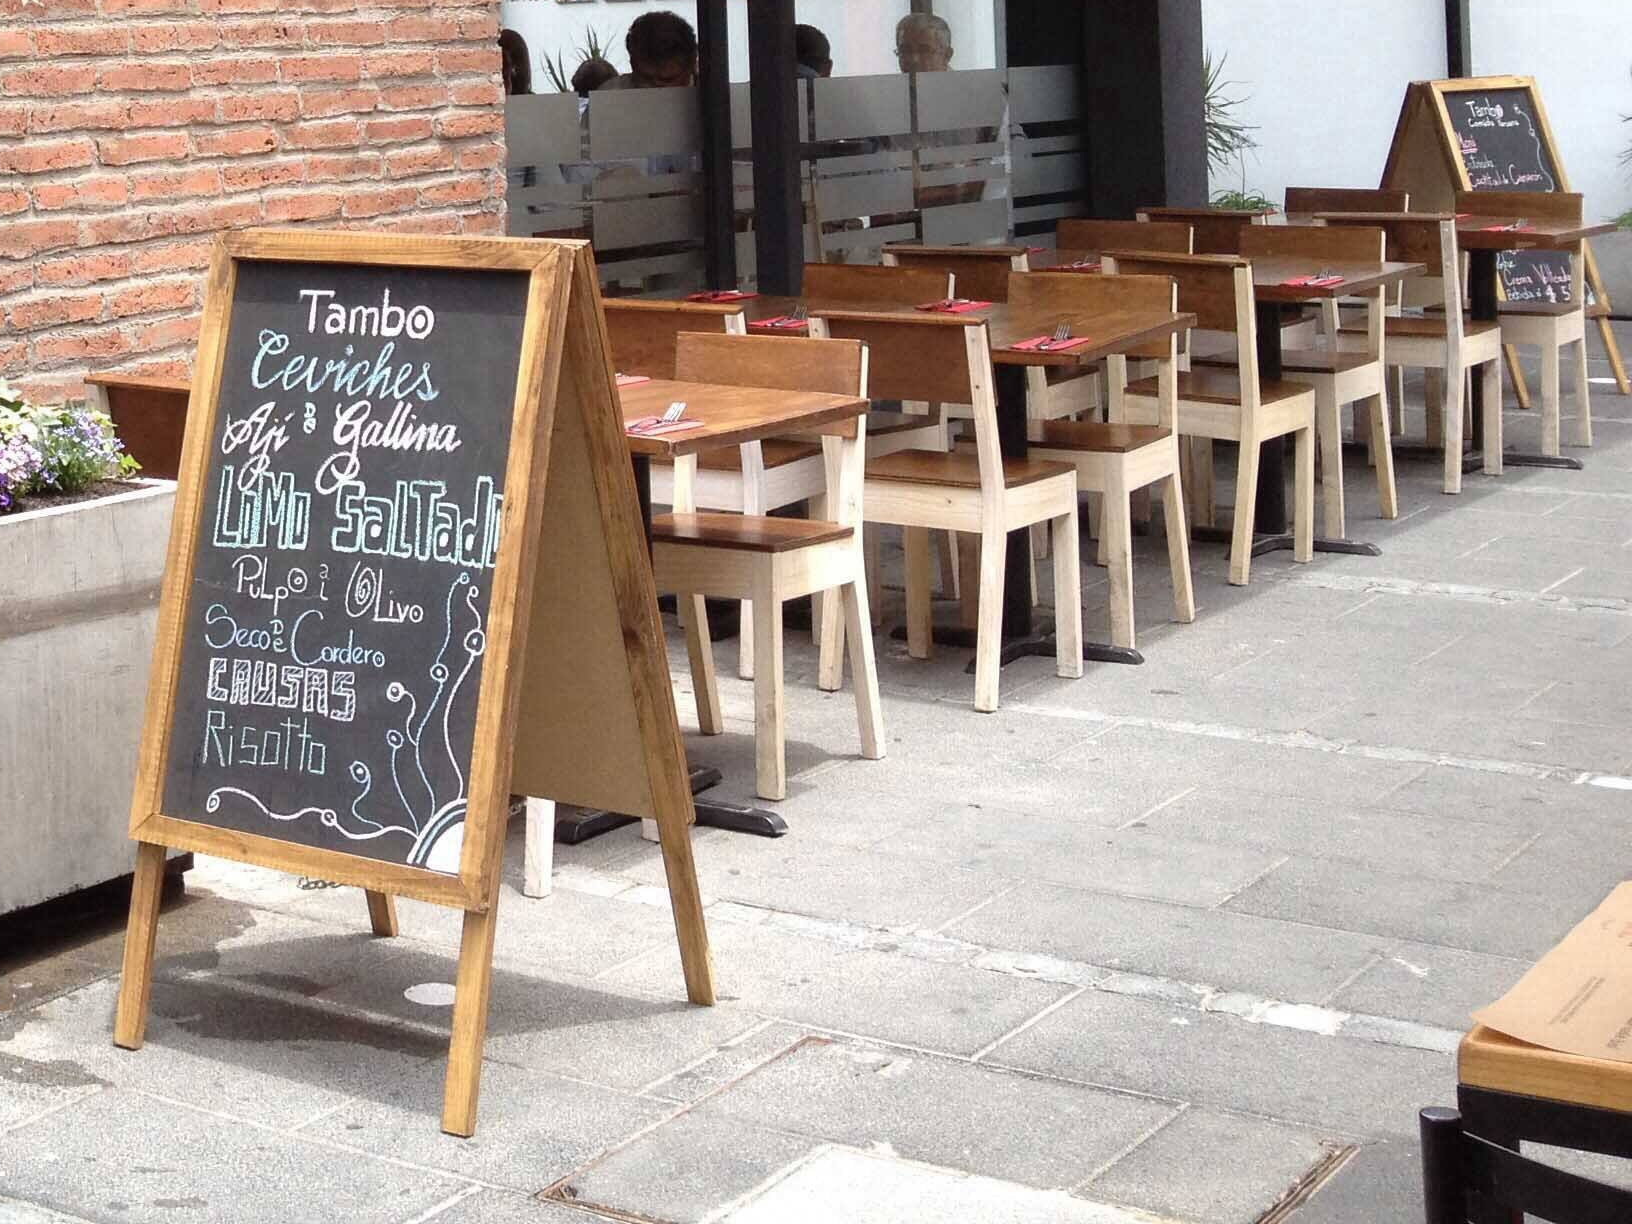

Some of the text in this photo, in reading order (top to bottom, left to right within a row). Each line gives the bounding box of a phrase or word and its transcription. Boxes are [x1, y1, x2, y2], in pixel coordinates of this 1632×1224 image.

[1465, 97, 1504, 119] Tambo
[299, 287, 435, 339] Tambo
[251, 328, 440, 401] Ceviches
[315, 399, 463, 495] Gallina
[204, 603, 271, 648] Seco
[290, 609, 386, 667] Cordero
[206, 657, 357, 721] CAUSAS
[202, 710, 326, 775] Risotto
